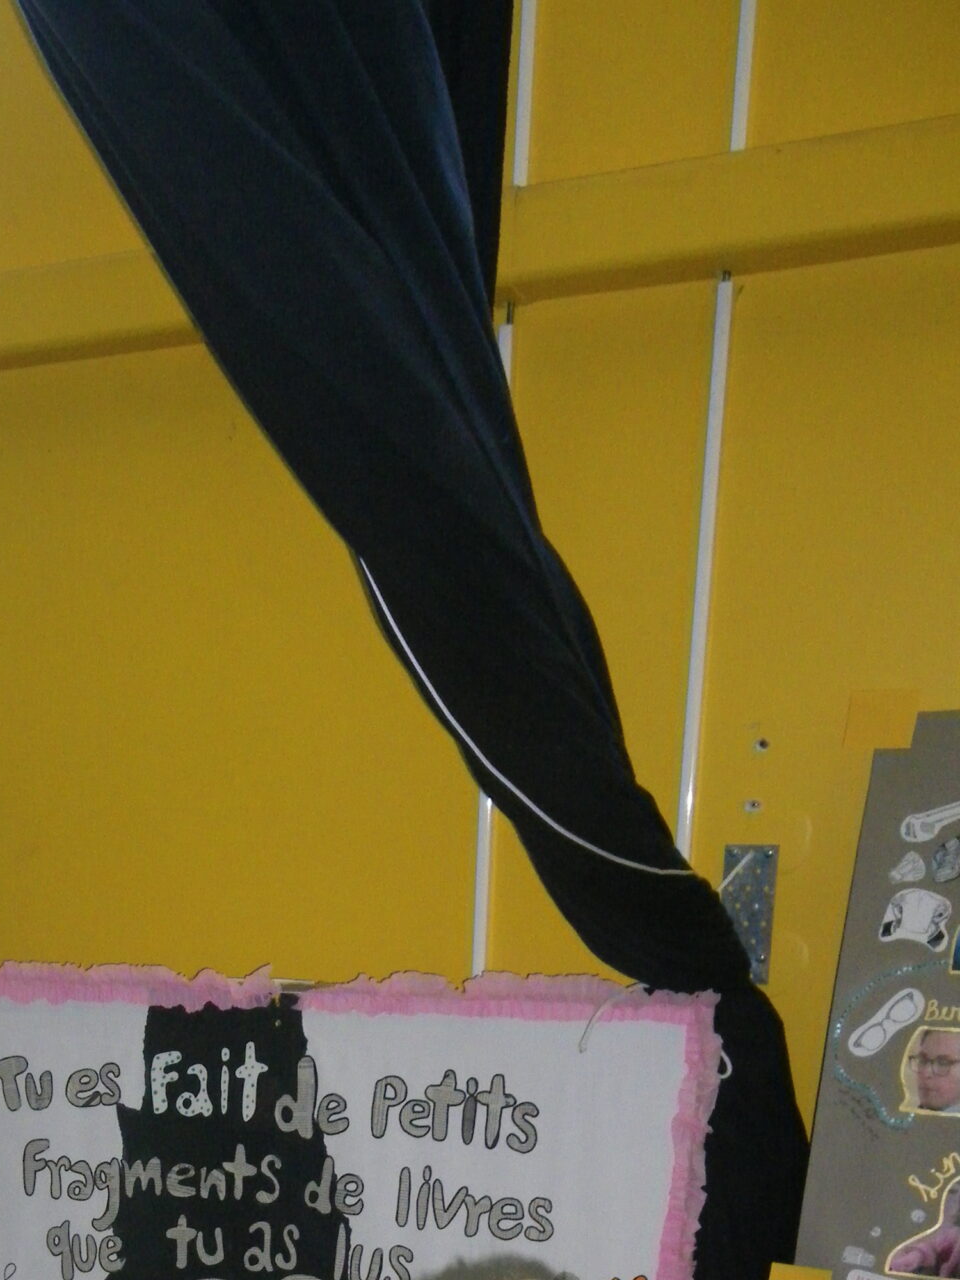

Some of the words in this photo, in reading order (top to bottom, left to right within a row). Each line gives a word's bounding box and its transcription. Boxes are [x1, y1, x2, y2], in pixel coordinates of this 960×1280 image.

[65, 1062, 121, 1107] es
[151, 1041, 269, 1122] Fait
[274, 1055, 349, 1139] de
[371, 1069, 539, 1153] Petits
[22, 1138, 282, 1231] Fragments
[304, 1155, 364, 1215] de
[395, 1165, 554, 1242] livres
[166, 1214, 225, 1269] tu
[243, 1221, 300, 1272] as
